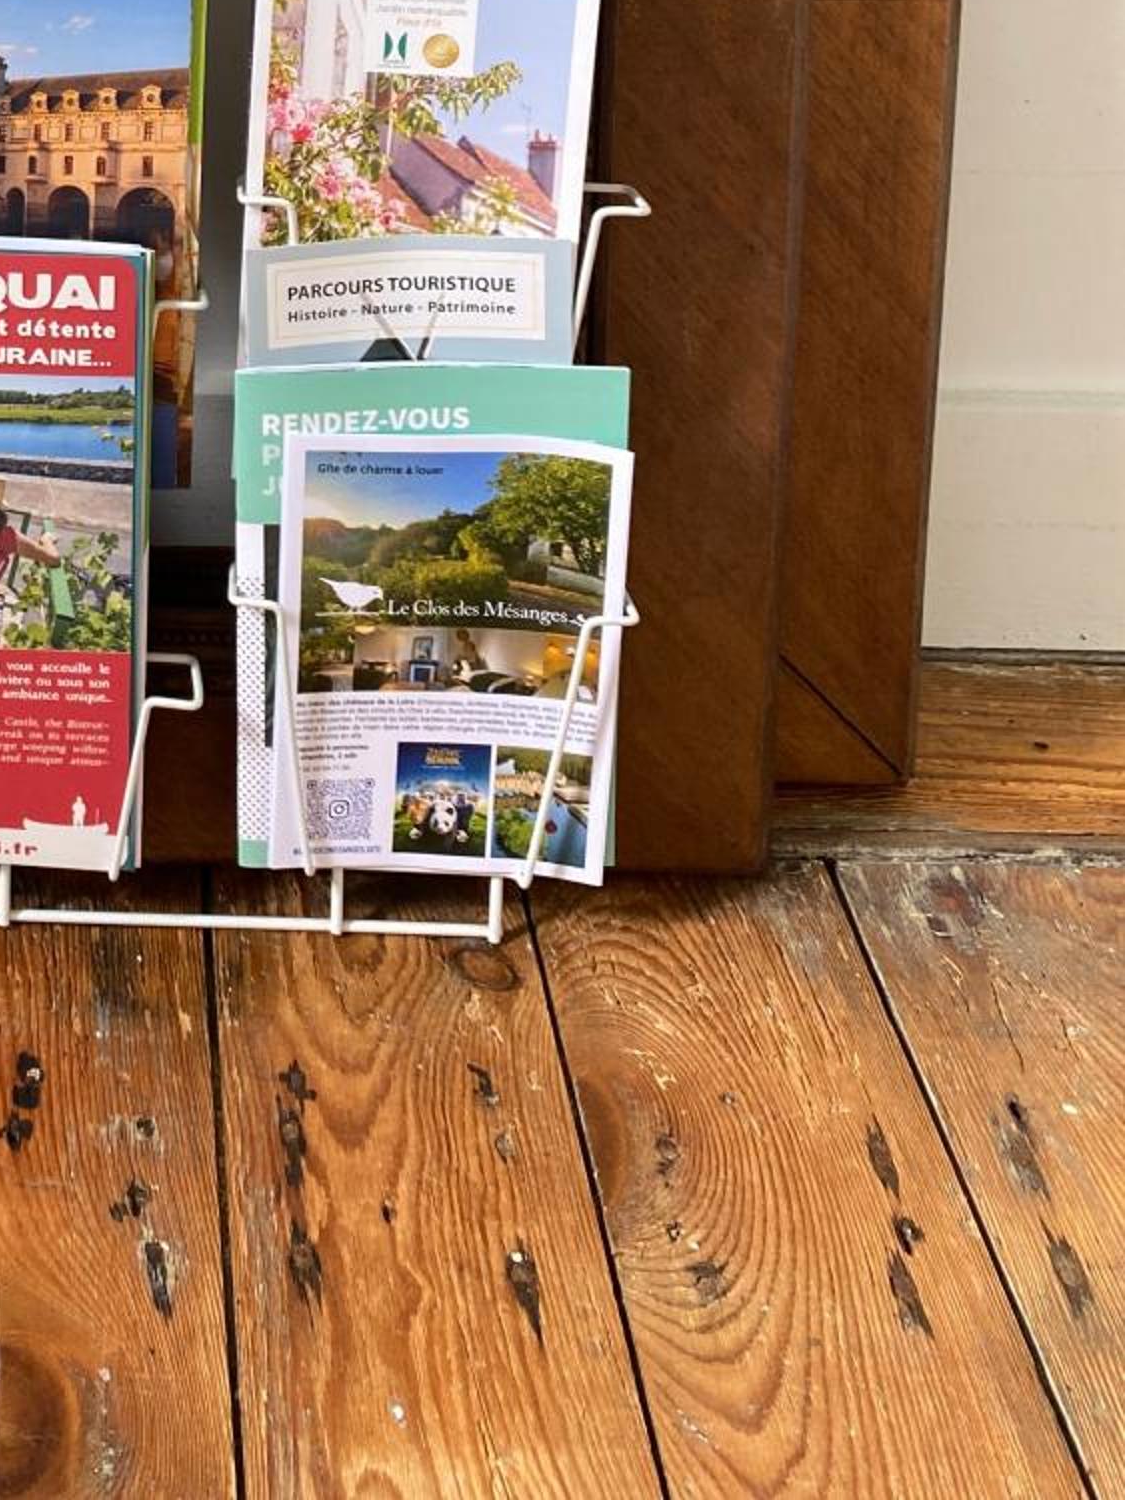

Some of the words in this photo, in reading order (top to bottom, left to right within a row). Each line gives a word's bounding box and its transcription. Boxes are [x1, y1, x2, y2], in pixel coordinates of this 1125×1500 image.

[288, 279, 383, 300] PARCOURS
[388, 276, 516, 293] TOURISTIQUE
[288, 308, 347, 322] Histoire
[361, 302, 414, 315] Nature
[428, 302, 516, 314] Patrimoine
[17, 319, 116, 339] détente
[262, 407, 470, 436] RENDEZ-VOUS
[343, 463, 357, 474] de
[360, 464, 402, 475] charme
[416, 465, 444, 475] louer
[387, 600, 410, 615] Le
[414, 600, 450, 616] Clos
[454, 600, 480, 617] des
[484, 601, 568, 626] Mésanges
[6, 662, 33, 671] vous
